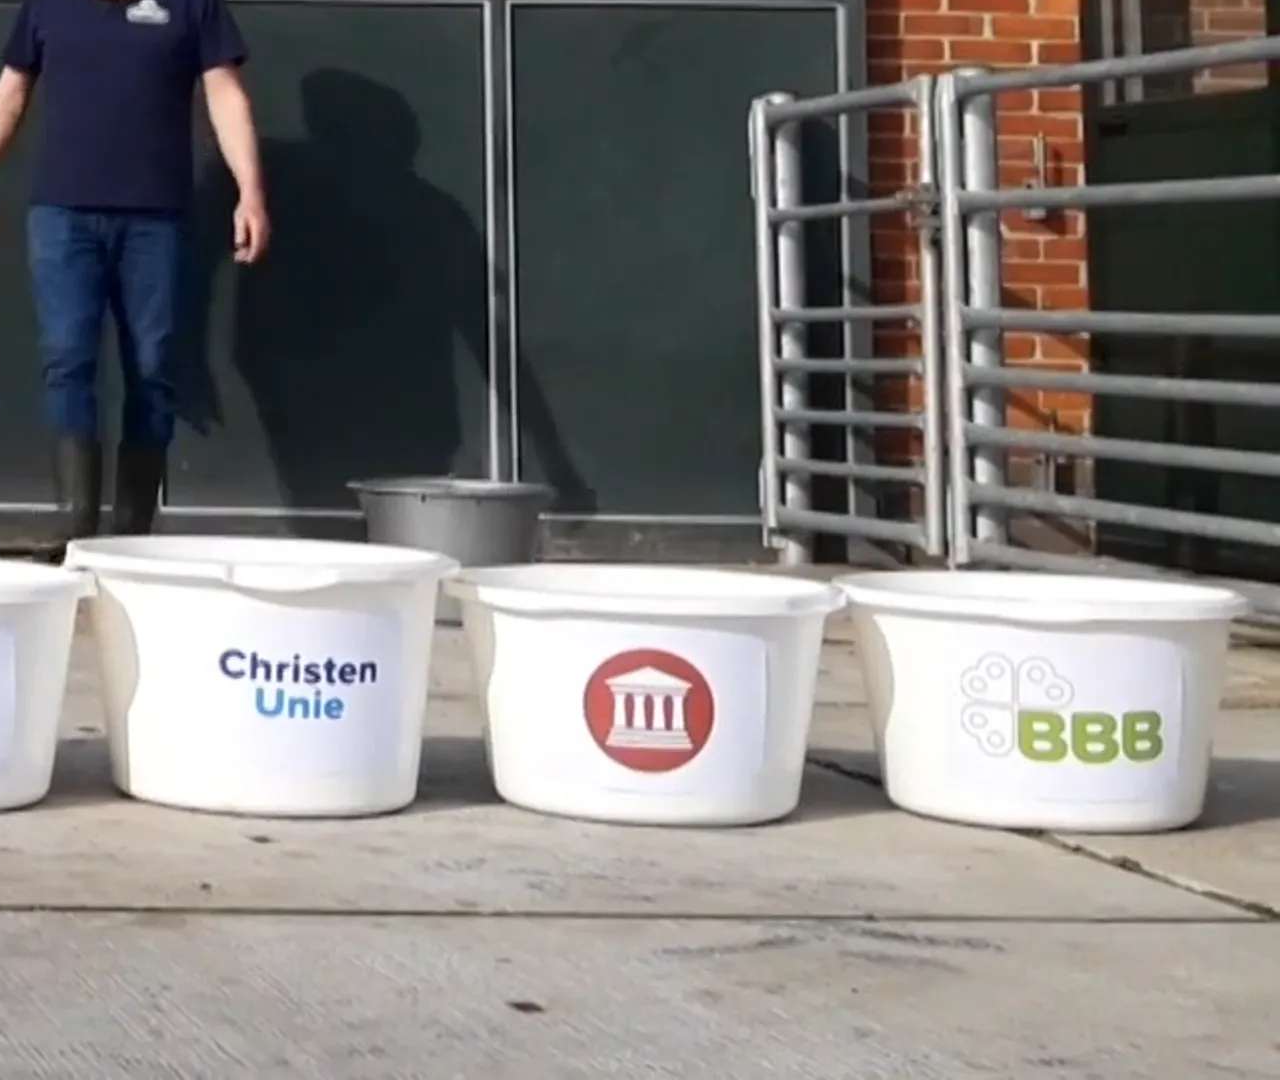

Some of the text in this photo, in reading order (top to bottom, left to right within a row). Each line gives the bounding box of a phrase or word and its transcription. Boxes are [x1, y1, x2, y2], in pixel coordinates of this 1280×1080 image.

[219, 649, 378, 685] Christen
[256, 688, 344, 720] Unie
[1017, 710, 1164, 764] BBB
